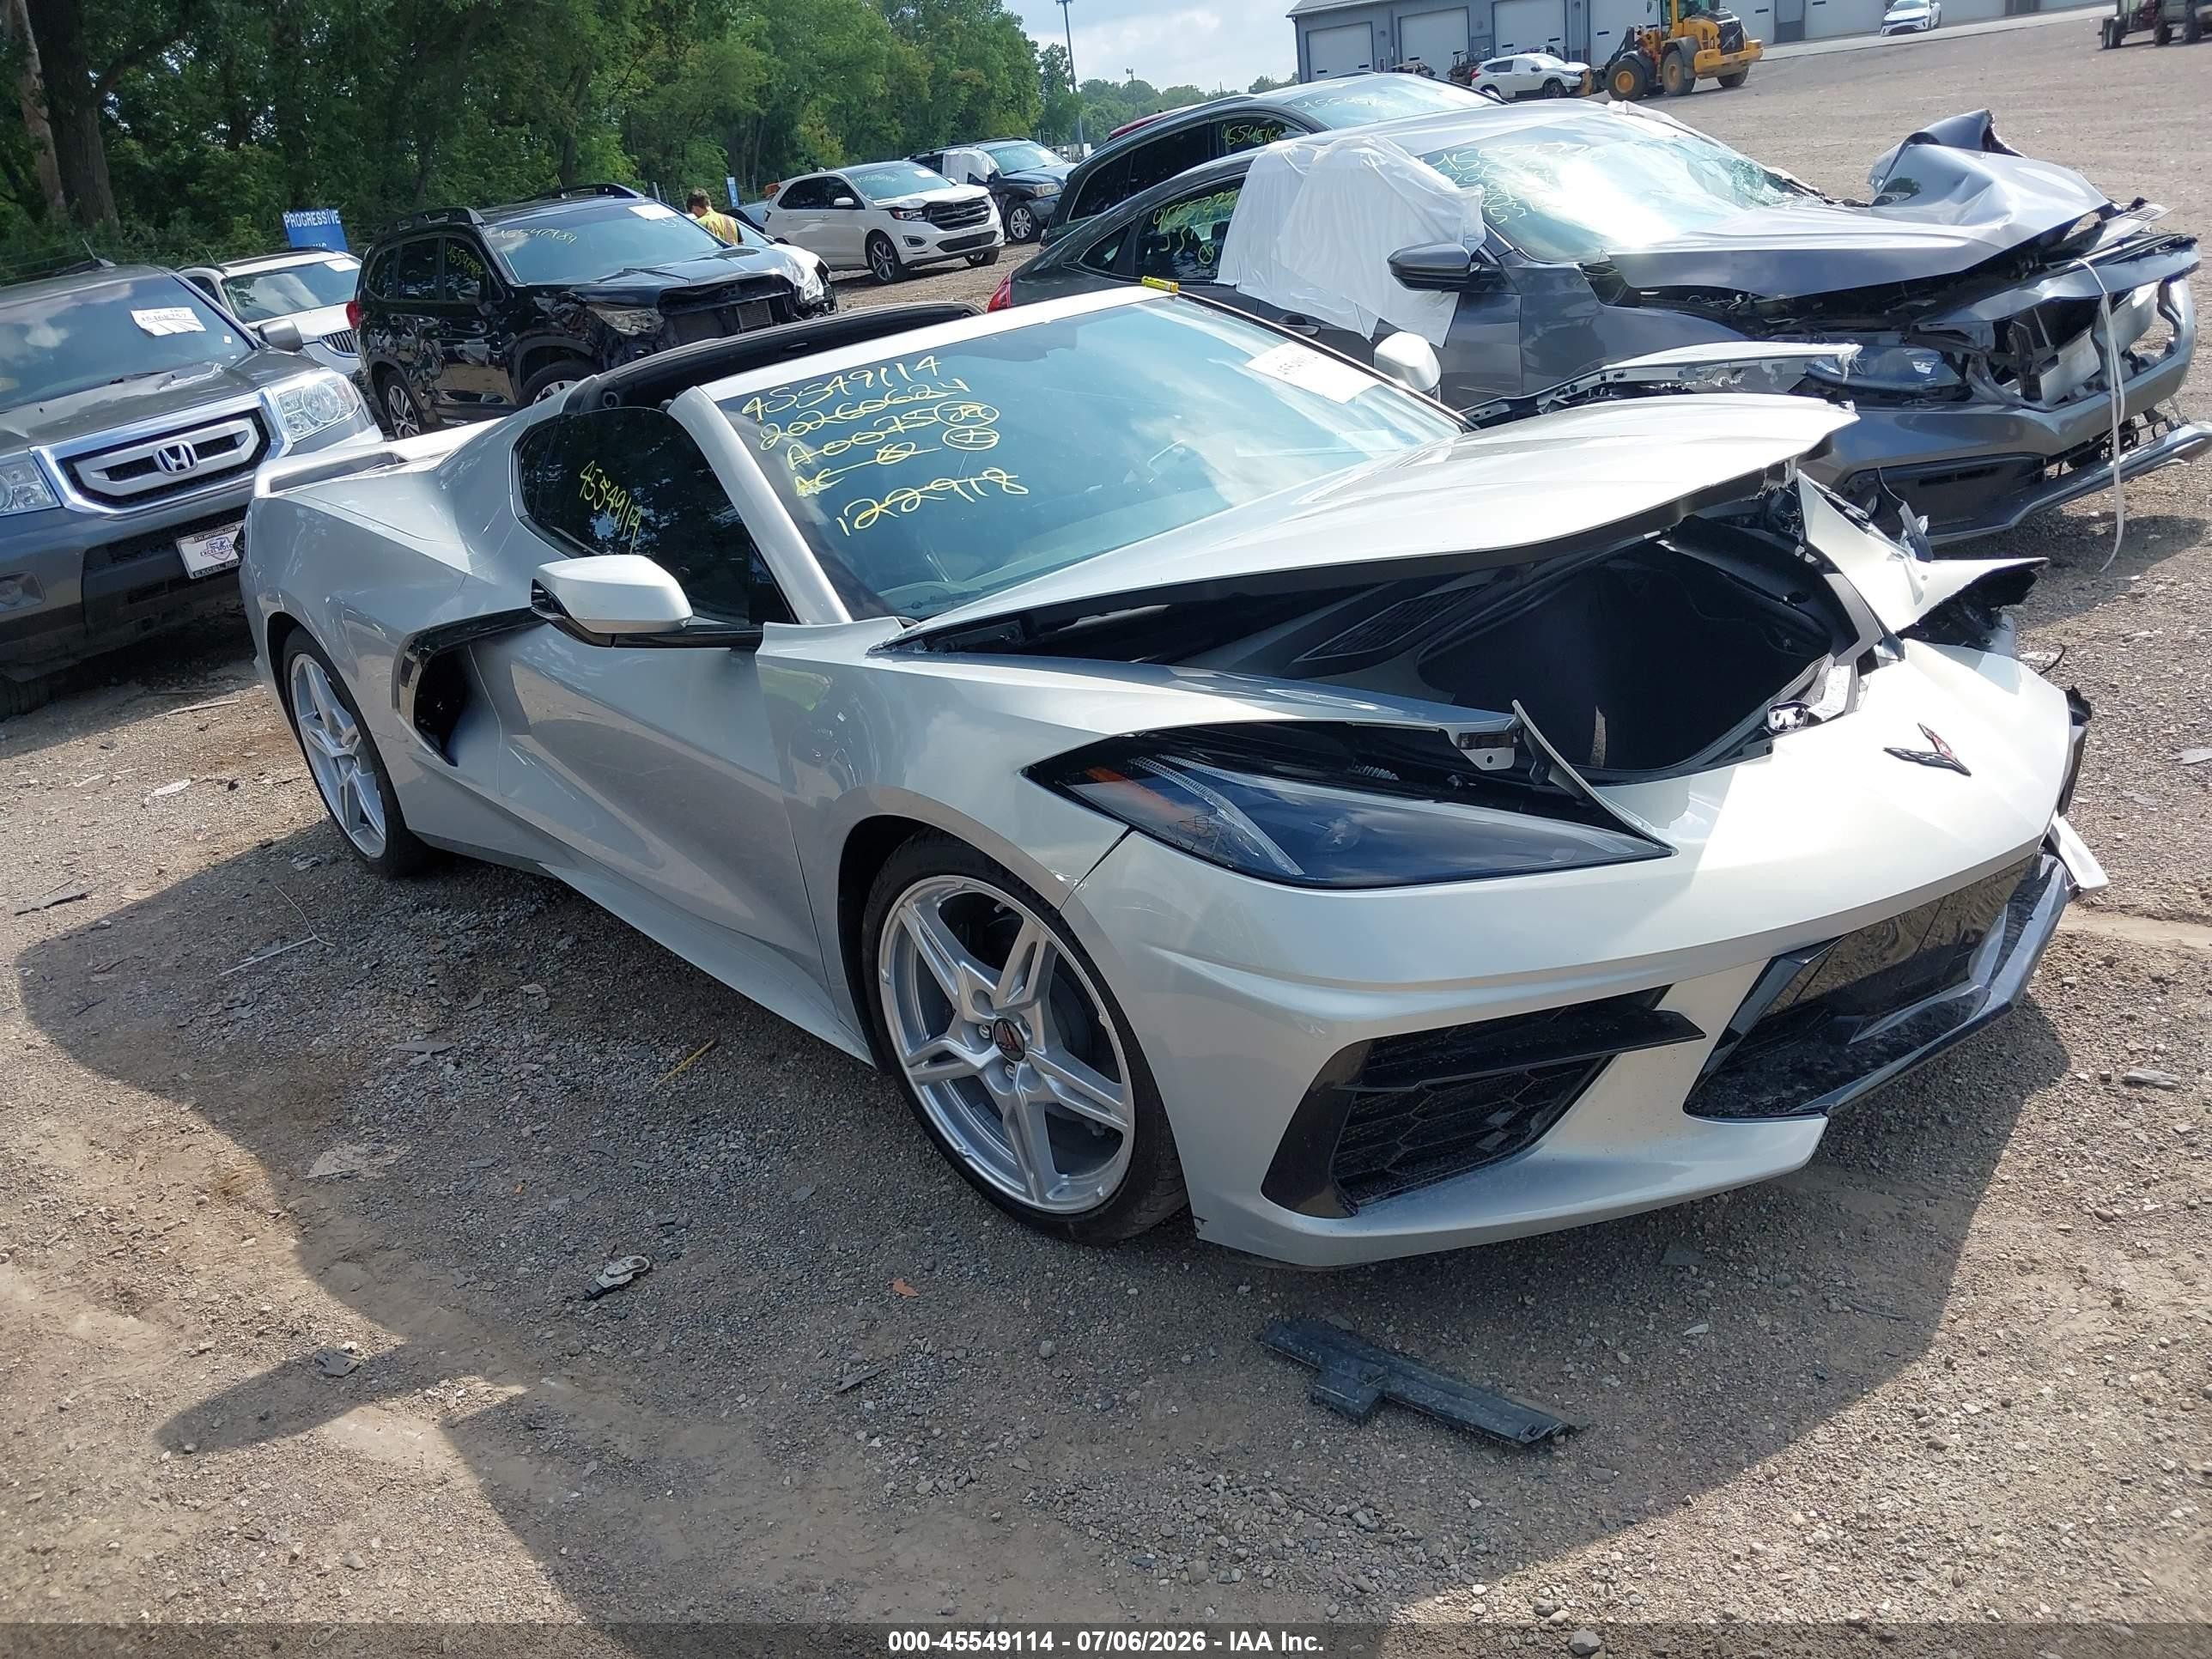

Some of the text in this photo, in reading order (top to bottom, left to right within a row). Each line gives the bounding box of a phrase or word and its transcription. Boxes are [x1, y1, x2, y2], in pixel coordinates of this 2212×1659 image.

[283, 209, 341, 229] PROGRESSIVE
[742, 356, 941, 422] 45549114
[760, 378, 971, 451] 20260624
[580, 460, 642, 555] 45549114
[836, 467, 1029, 537] 122918
